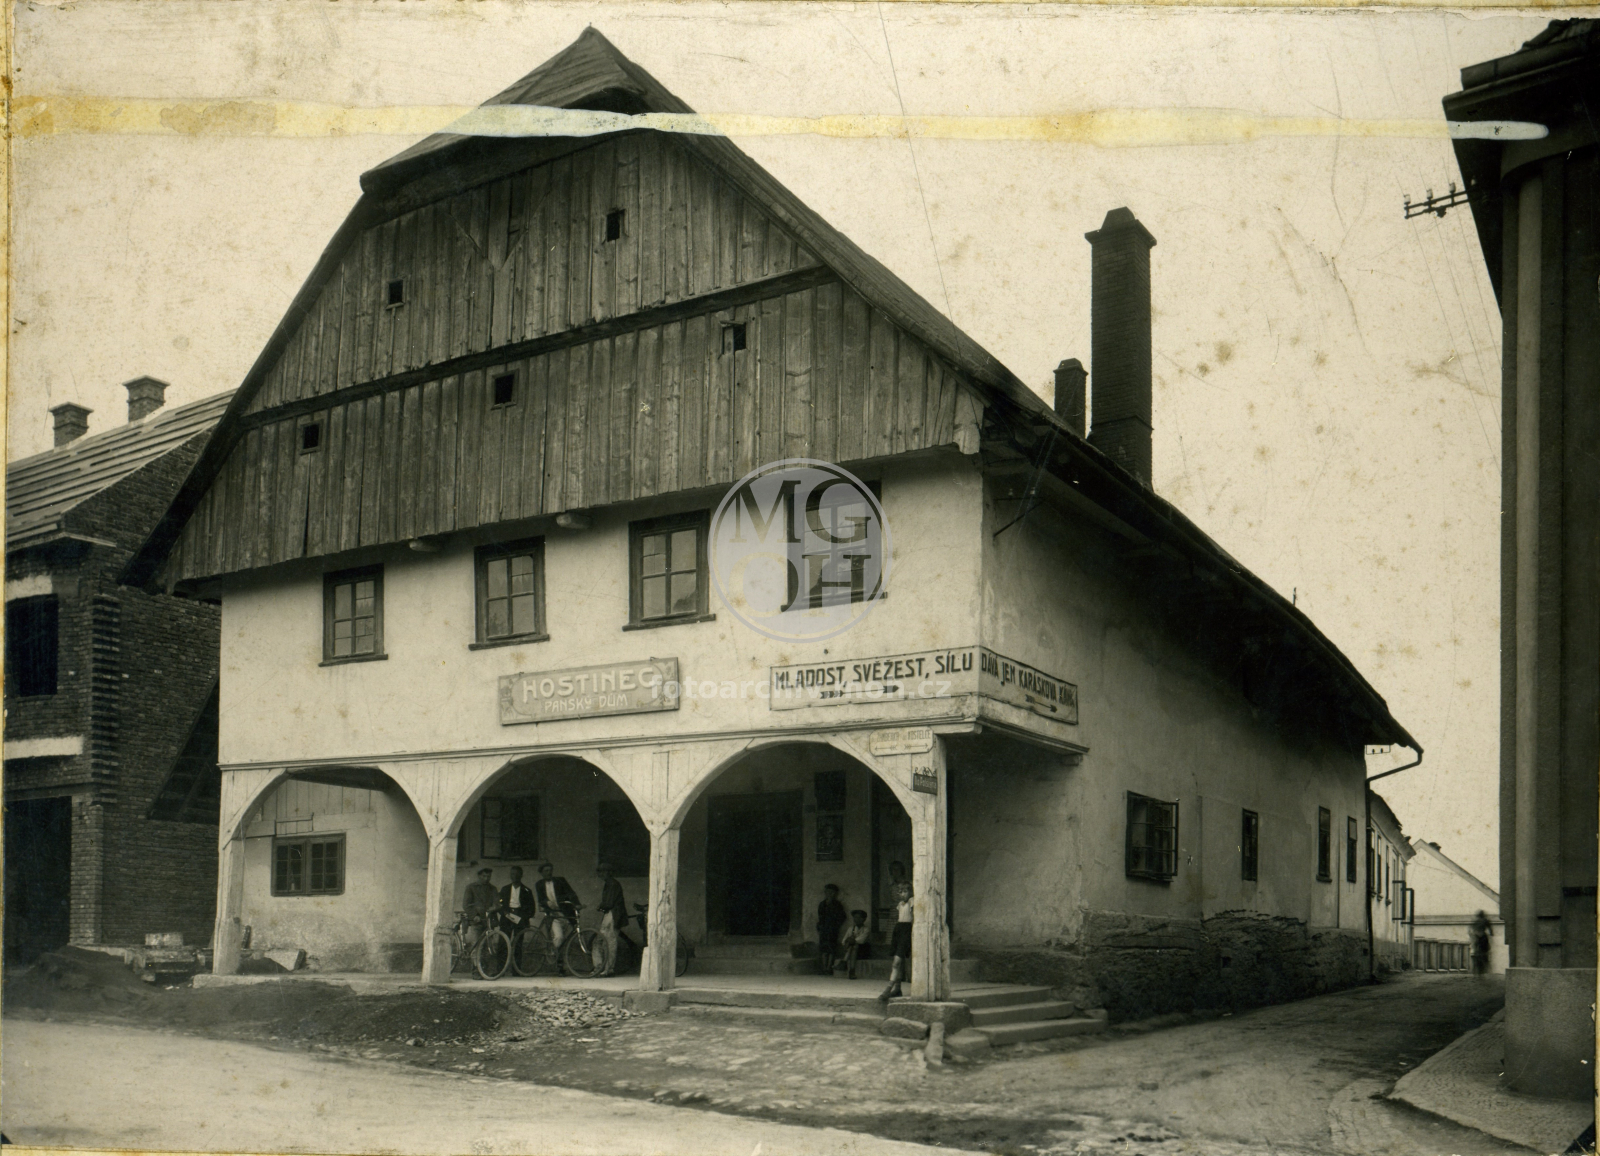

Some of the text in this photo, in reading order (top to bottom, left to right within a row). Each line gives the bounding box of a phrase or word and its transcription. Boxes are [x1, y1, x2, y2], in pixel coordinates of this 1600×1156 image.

[522, 667, 655, 704] HOSTINEC
[775, 651, 973, 690] MLADOST, SVĚŽEST, SÍLU
